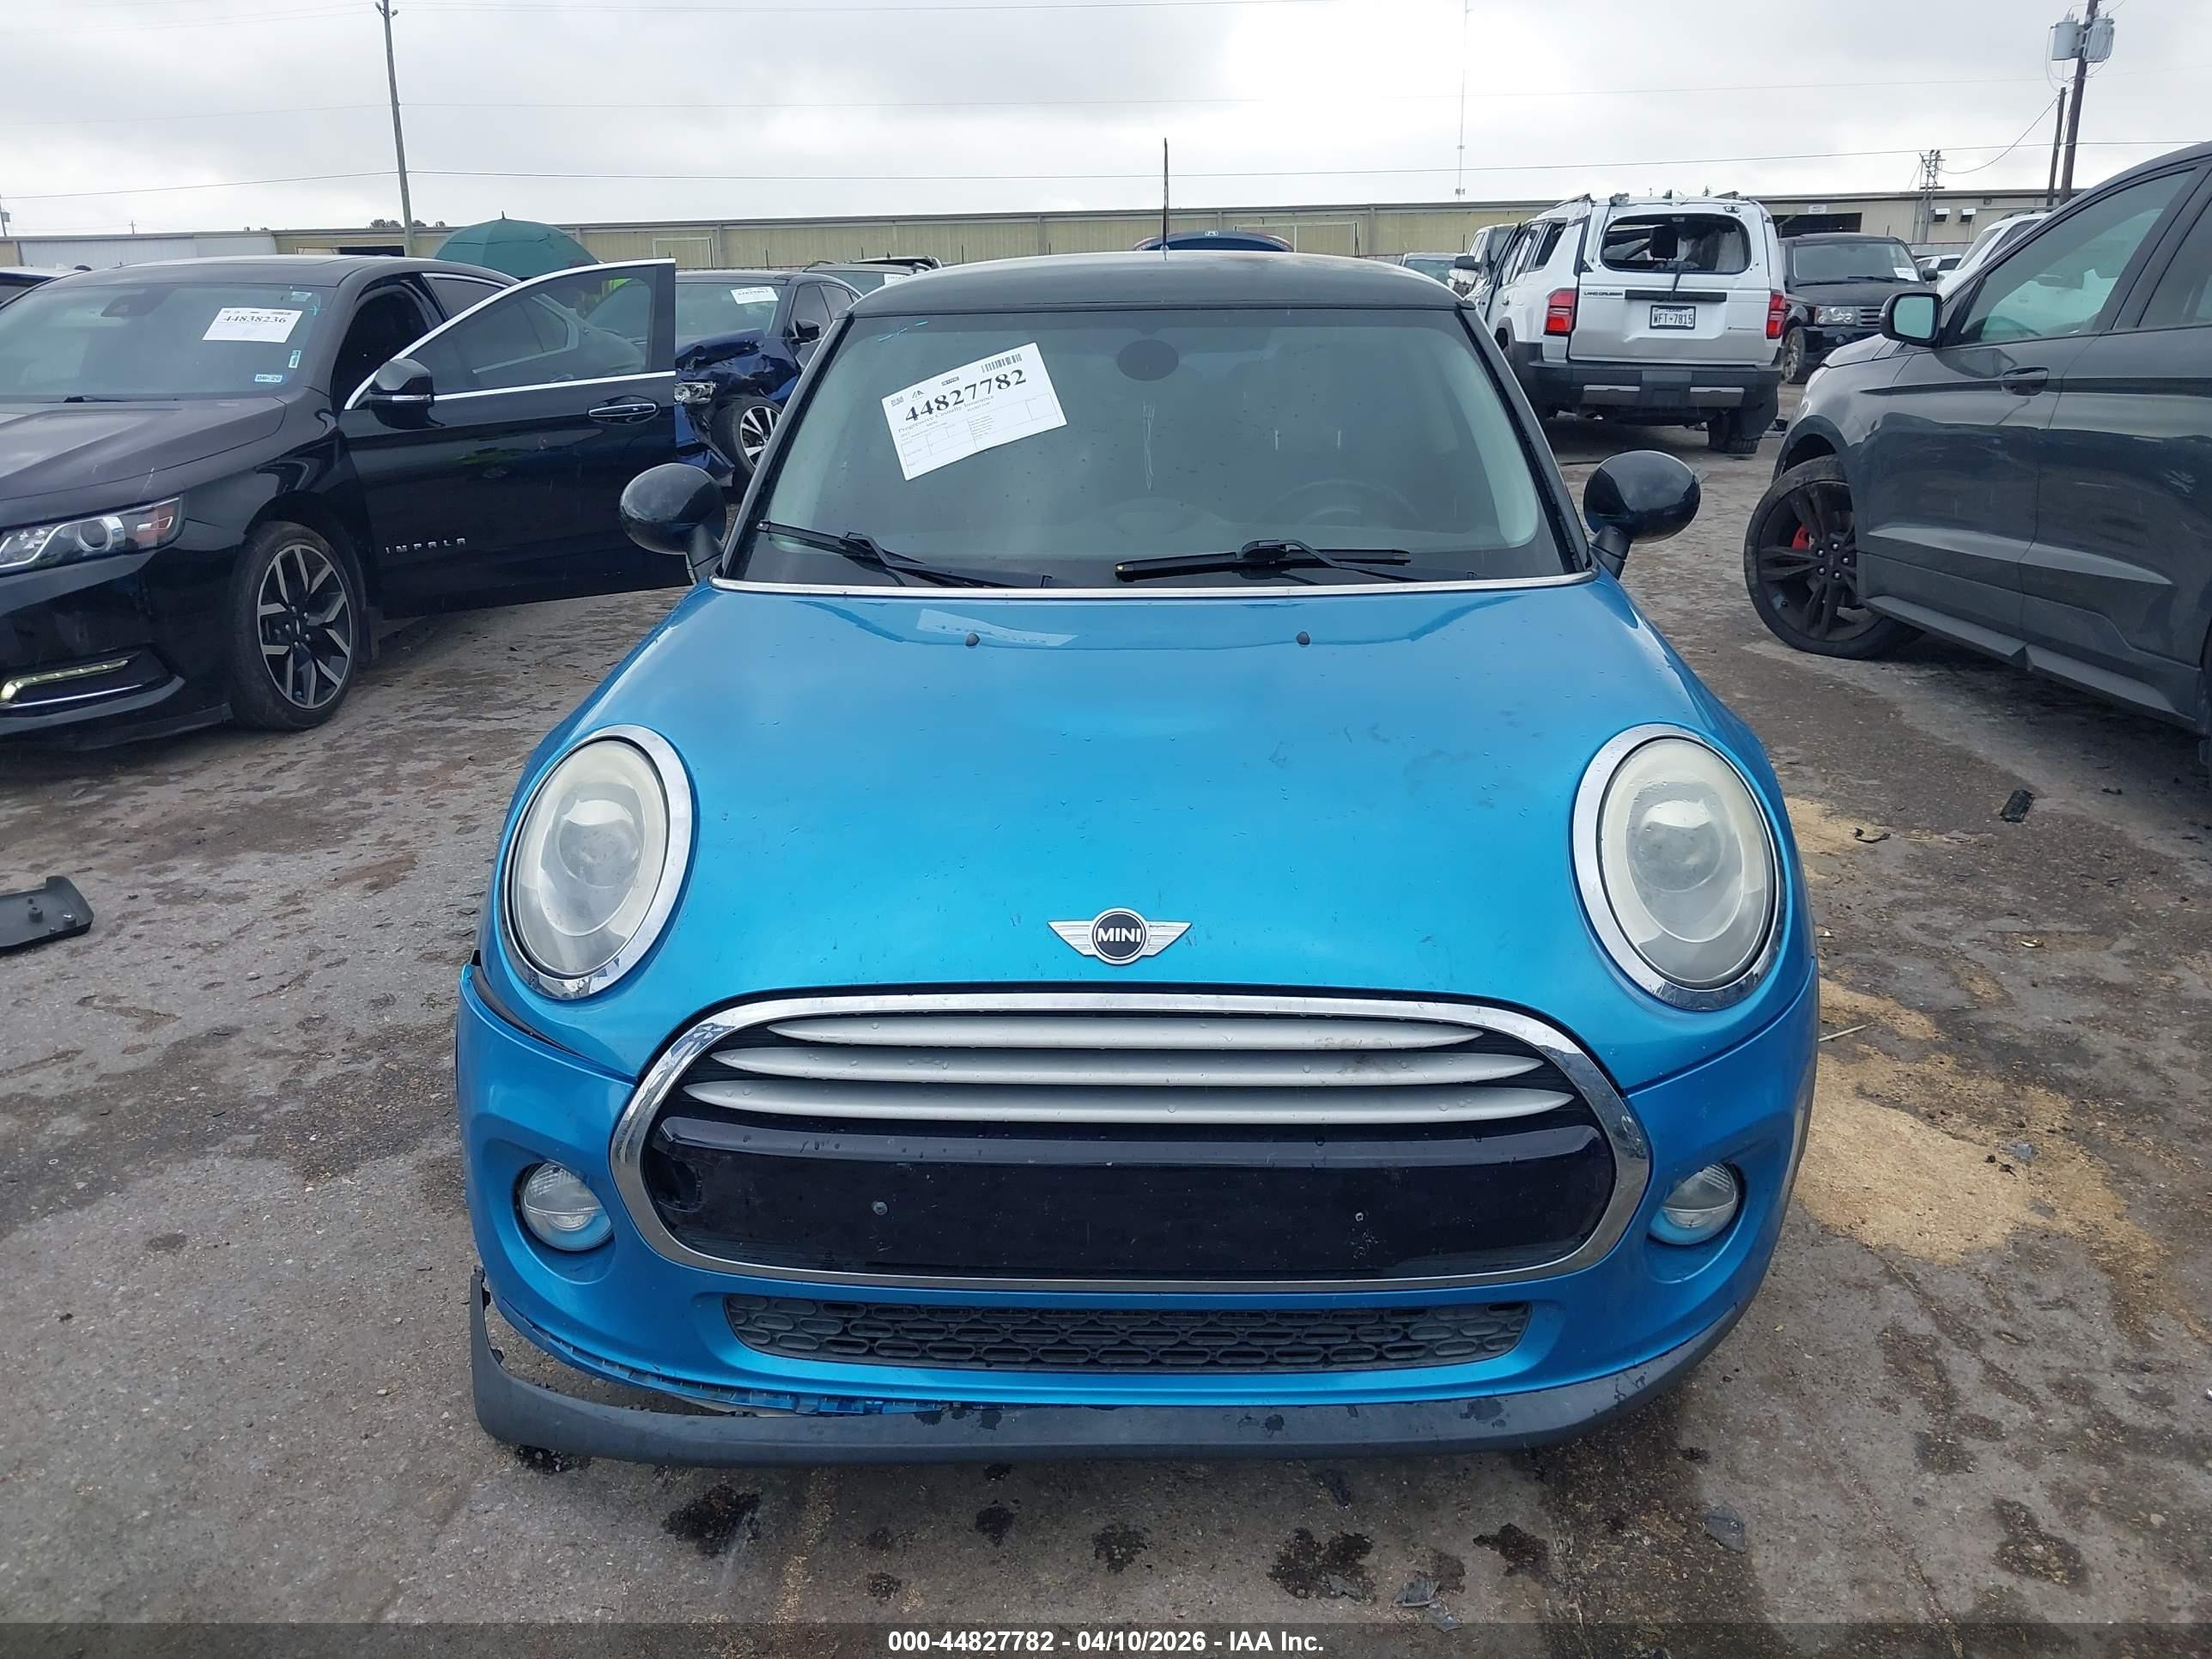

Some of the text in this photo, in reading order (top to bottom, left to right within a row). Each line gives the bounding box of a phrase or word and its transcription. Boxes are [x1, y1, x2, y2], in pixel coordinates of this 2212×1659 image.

[223, 315, 287, 324] 44838236
[905, 369, 1027, 422] 44827782
[385, 537, 465, 554] IMPALA
[1097, 927, 1141, 942] MINI
